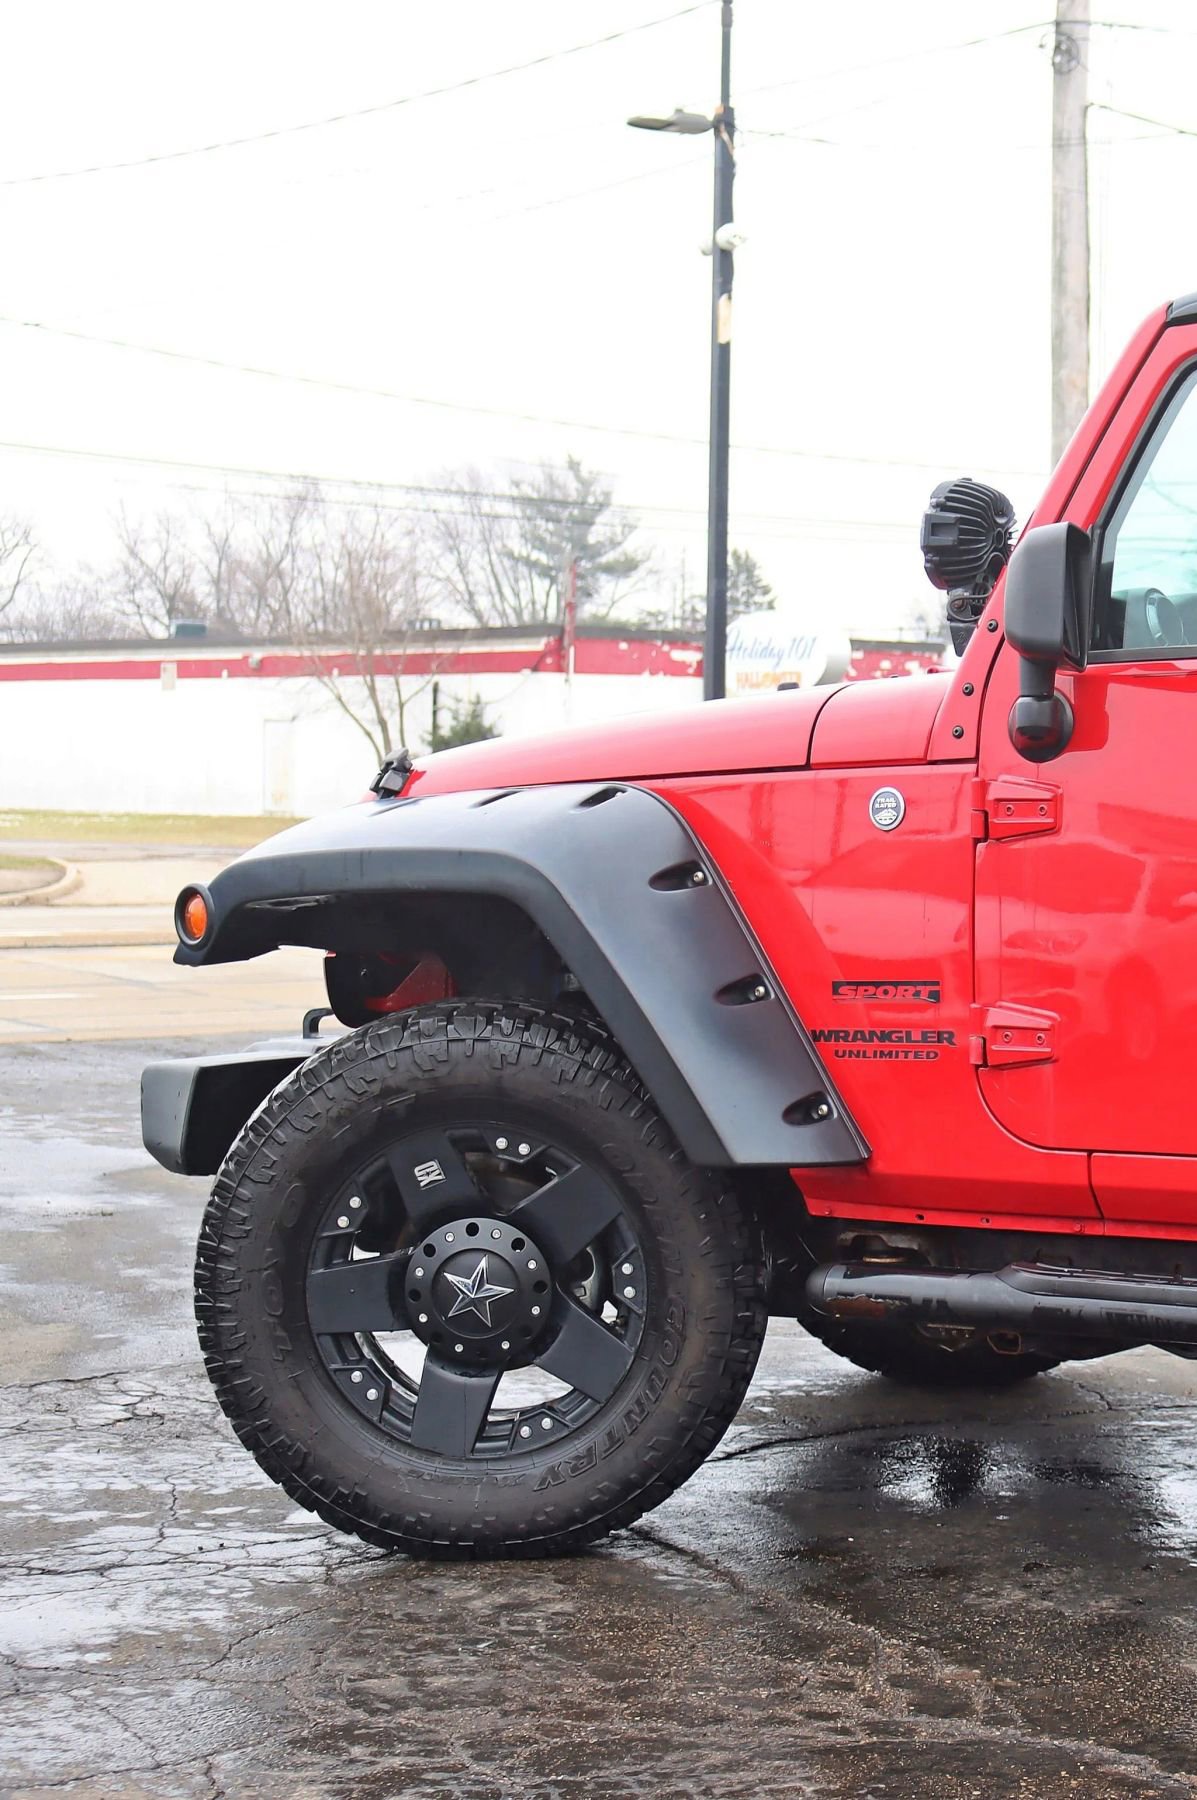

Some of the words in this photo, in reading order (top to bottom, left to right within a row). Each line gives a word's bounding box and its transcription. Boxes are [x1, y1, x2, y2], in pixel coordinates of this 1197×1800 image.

[725, 626, 785, 671] Holiday
[787, 635, 818, 660] 101
[837, 984, 941, 999] SPORT
[811, 1029, 957, 1046] WRANGLER
[834, 1049, 939, 1060] UNLIMITED
[533, 1297, 687, 1492] COUNTRY
